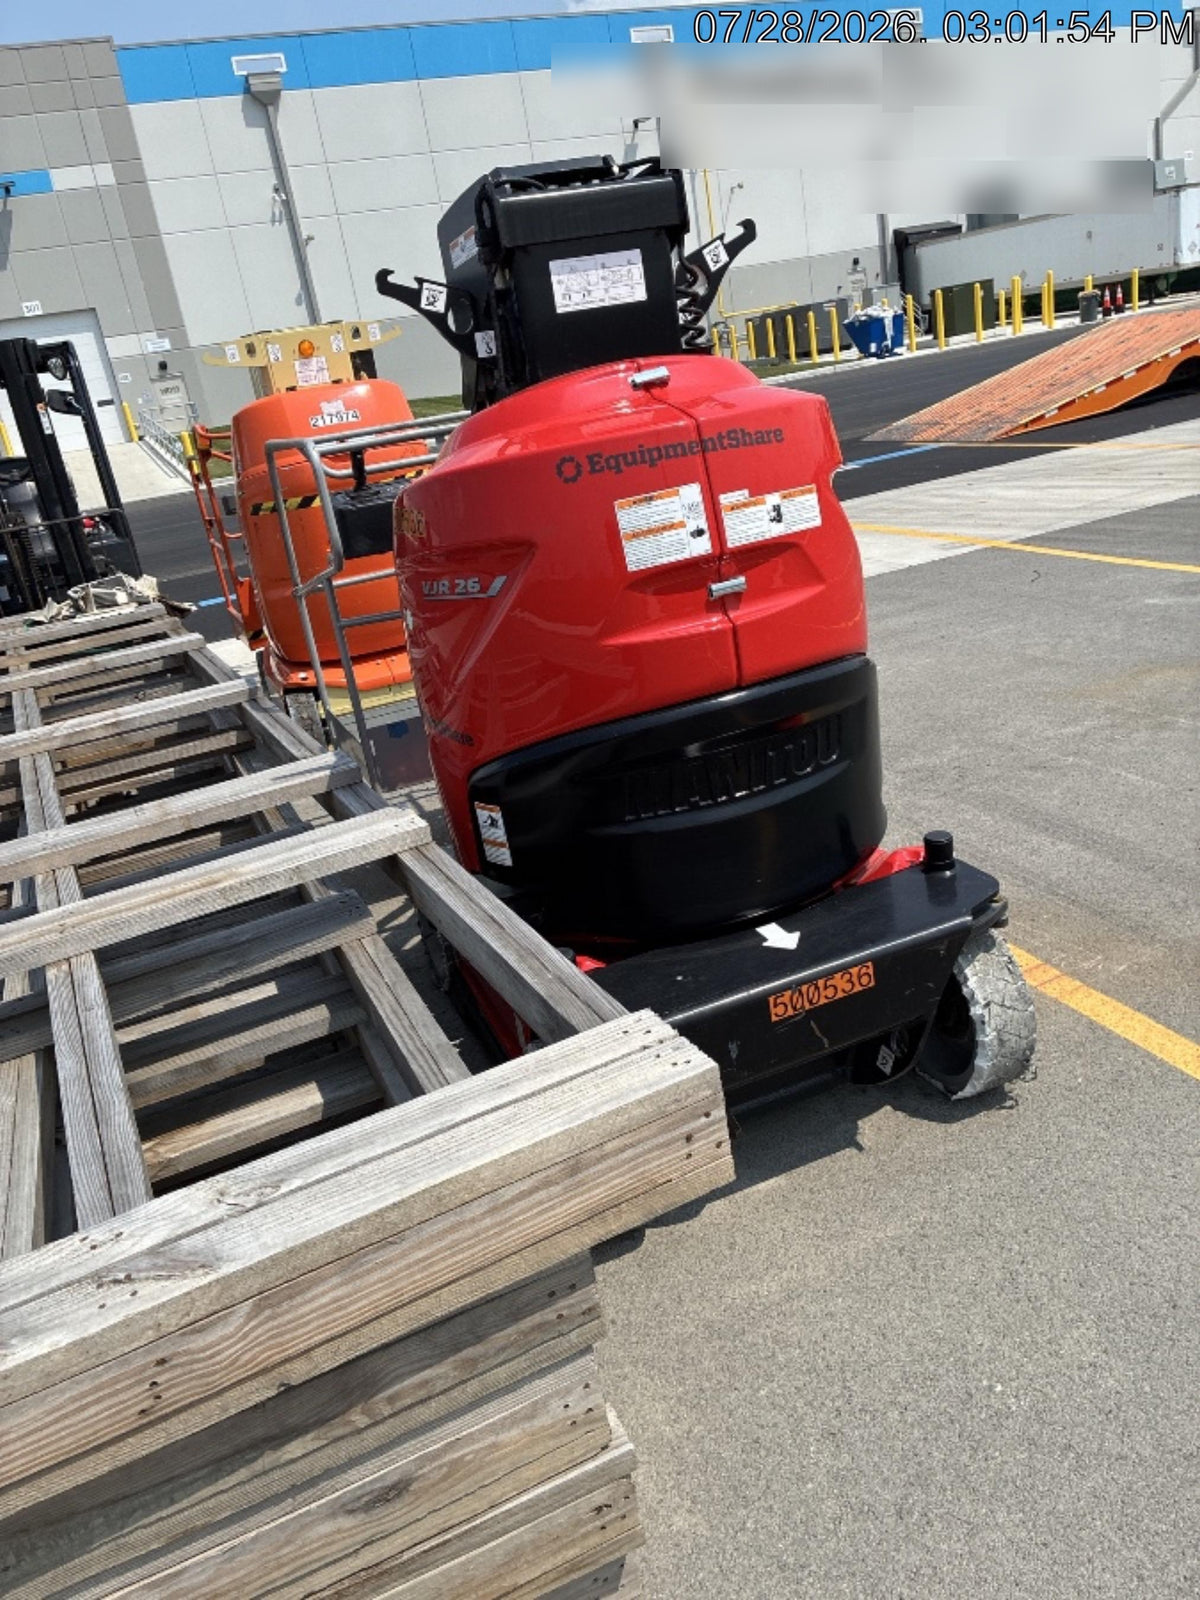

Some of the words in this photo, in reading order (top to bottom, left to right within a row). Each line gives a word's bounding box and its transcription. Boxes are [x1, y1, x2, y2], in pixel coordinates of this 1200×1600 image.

[586, 427, 785, 475] EquipmentShare
[421, 578, 450, 594] VJR
[454, 576, 481, 593] 26
[773, 964, 873, 1018] 500536
